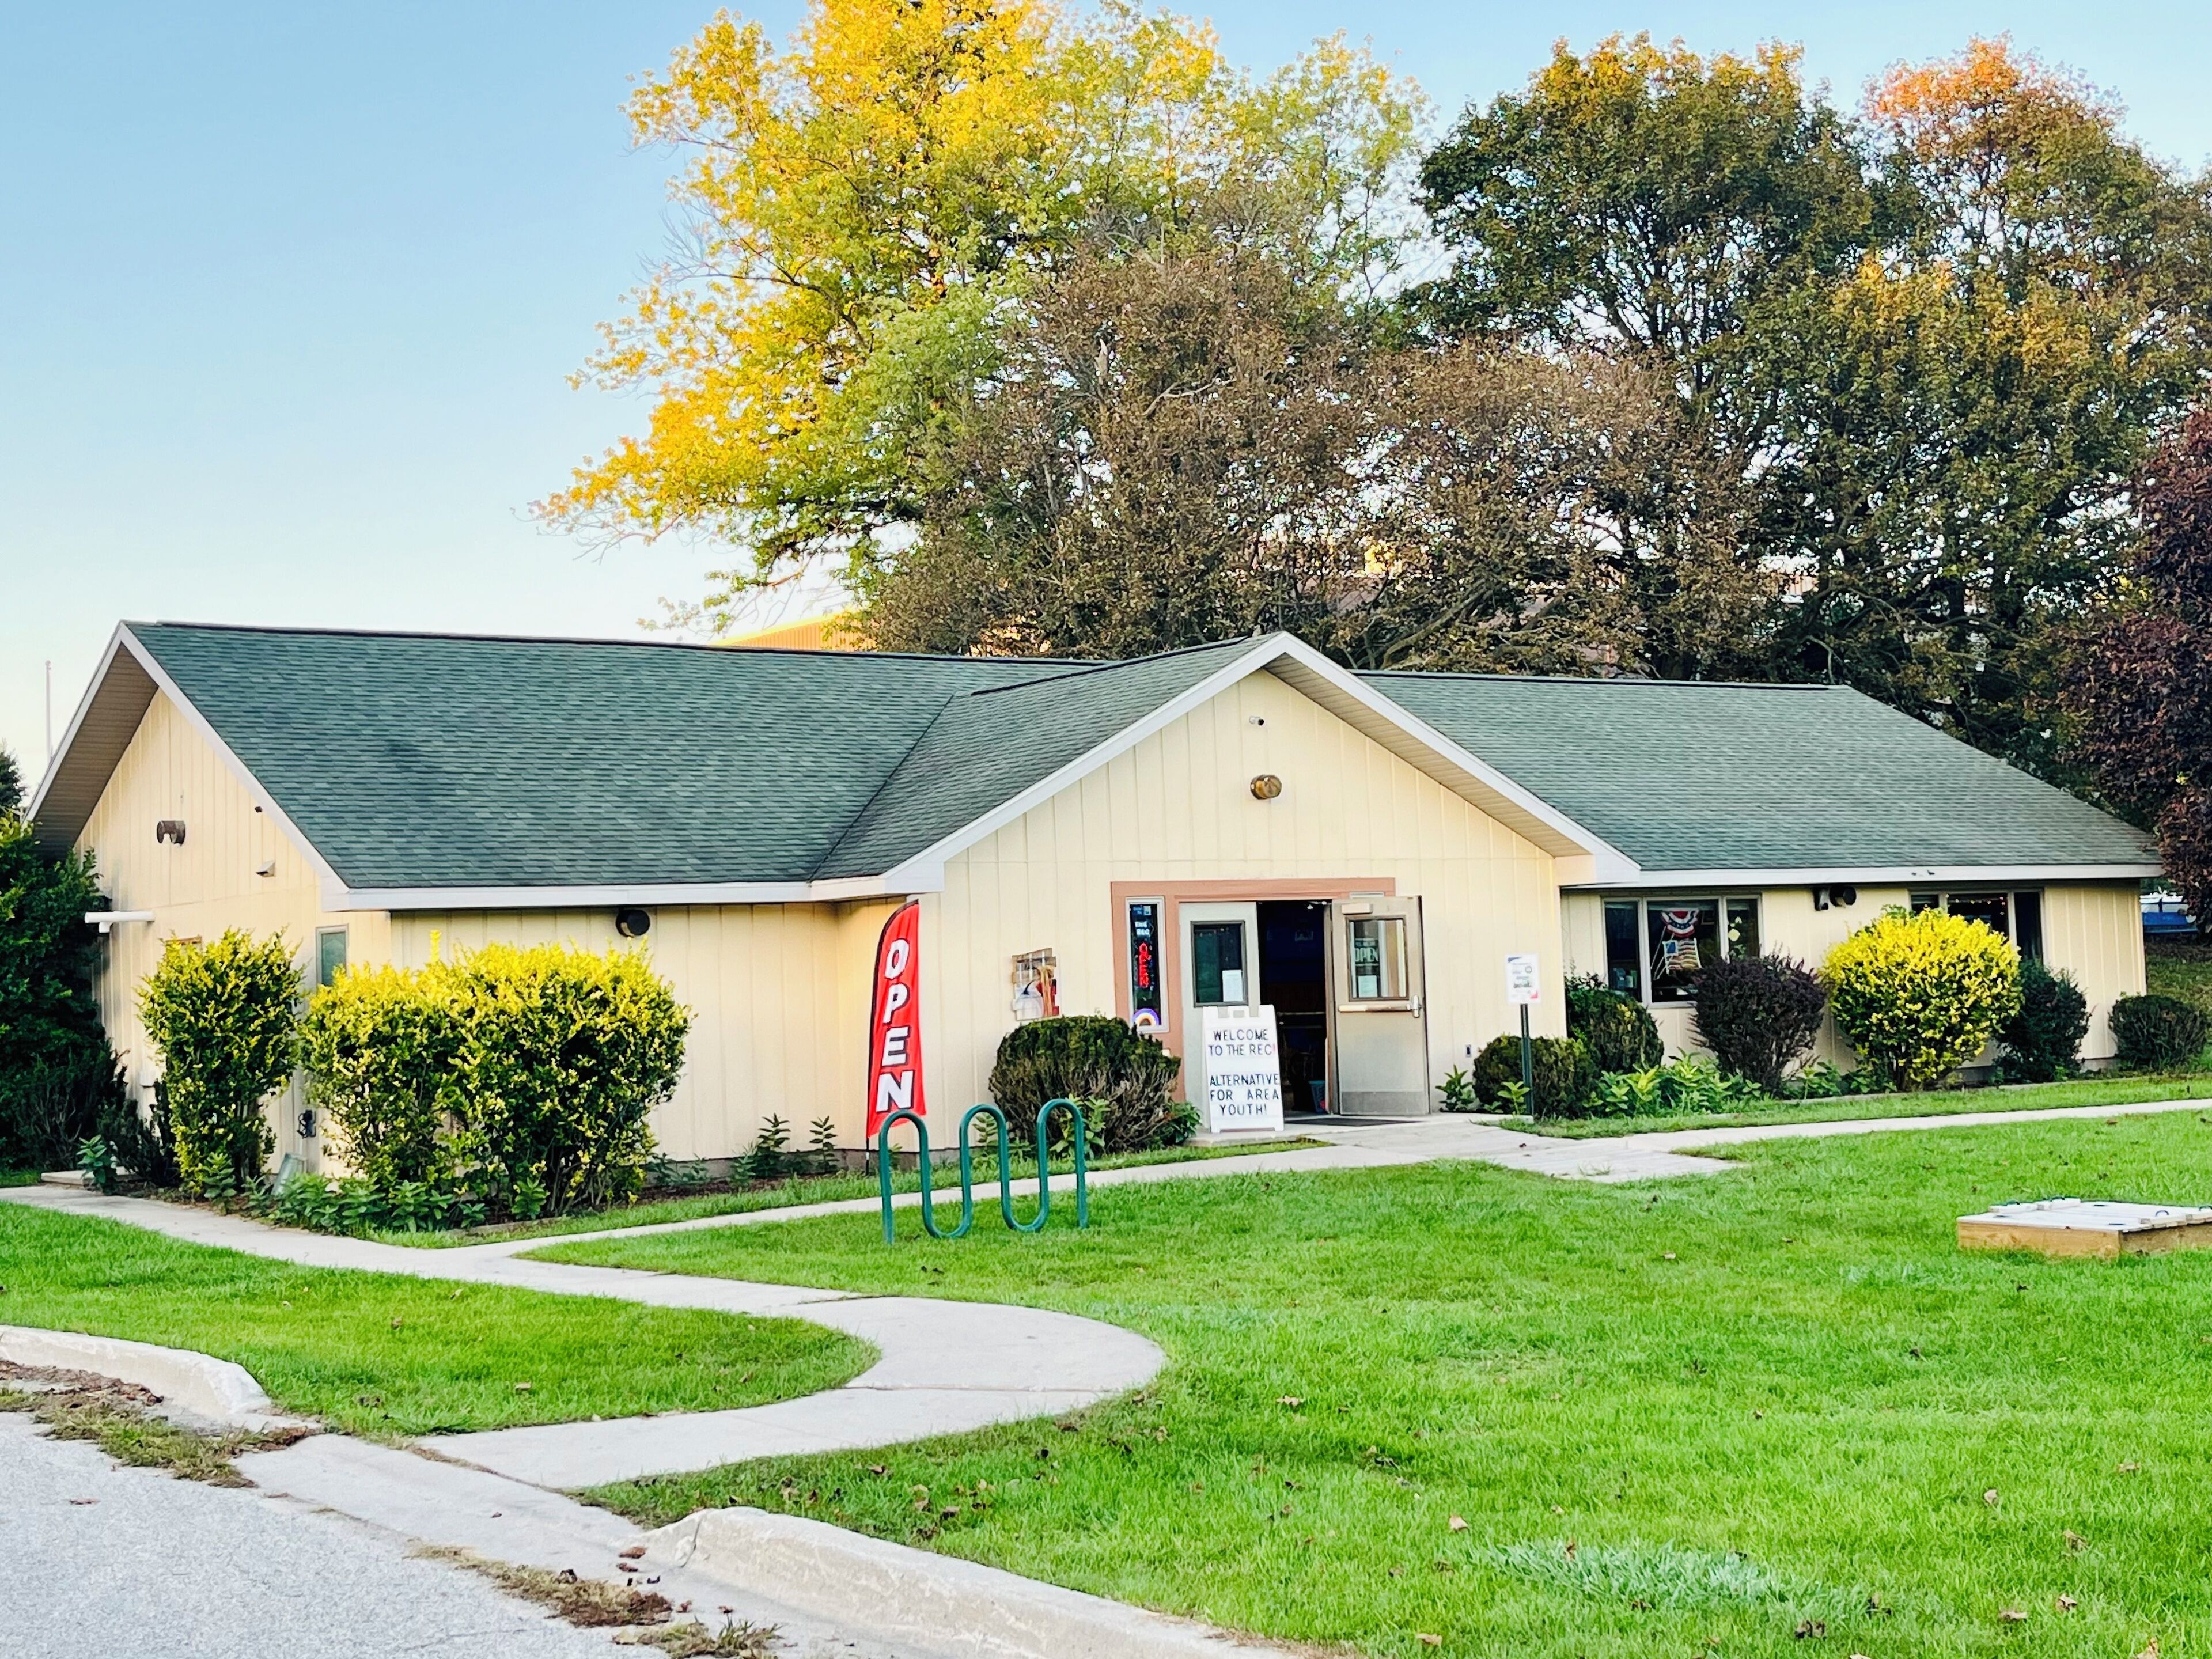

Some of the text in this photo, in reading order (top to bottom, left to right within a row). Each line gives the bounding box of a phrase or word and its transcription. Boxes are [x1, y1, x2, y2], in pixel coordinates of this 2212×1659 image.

[876, 939, 915, 1113] OPEN
[1214, 1029, 1268, 1041] WELCOME
[1208, 1044, 1222, 1056] TO
[1226, 1044, 1244, 1055] THE
[1210, 1074, 1279, 1086] ALTERNATIVE
[1210, 1088, 1279, 1101] FOR AREA
[1219, 1103, 1267, 1116] YOUTH!
